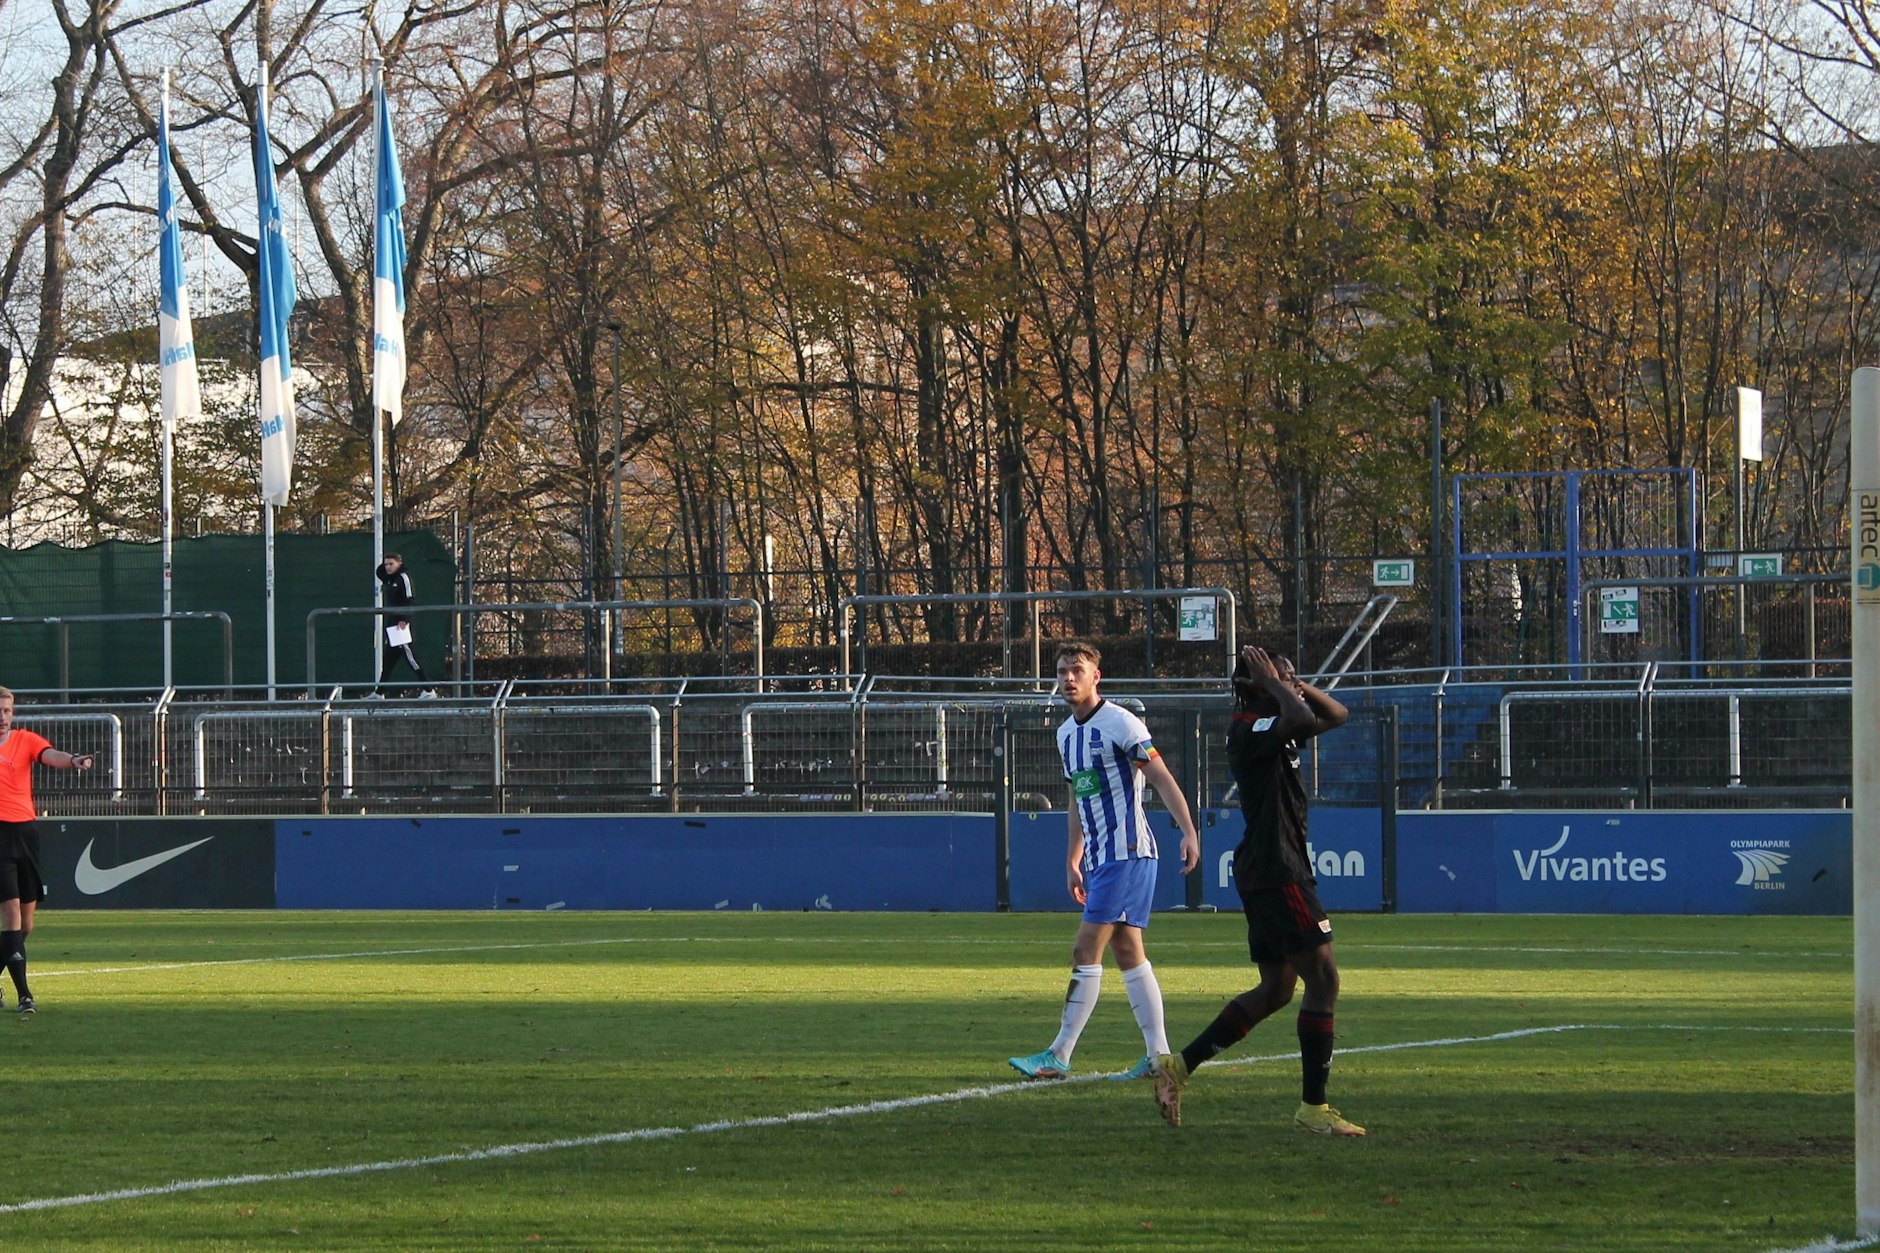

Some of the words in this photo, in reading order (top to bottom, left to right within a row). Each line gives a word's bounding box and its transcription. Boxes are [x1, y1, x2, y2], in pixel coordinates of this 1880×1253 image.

[1860, 494, 1880, 559] artec
[1075, 775, 1094, 789] AOK
[1512, 826, 1667, 882] Vivantes
[1729, 839, 1791, 849] OLYMPIAPARK
[1218, 841, 1365, 888] ptan
[1753, 881, 1786, 891] BERLIN
